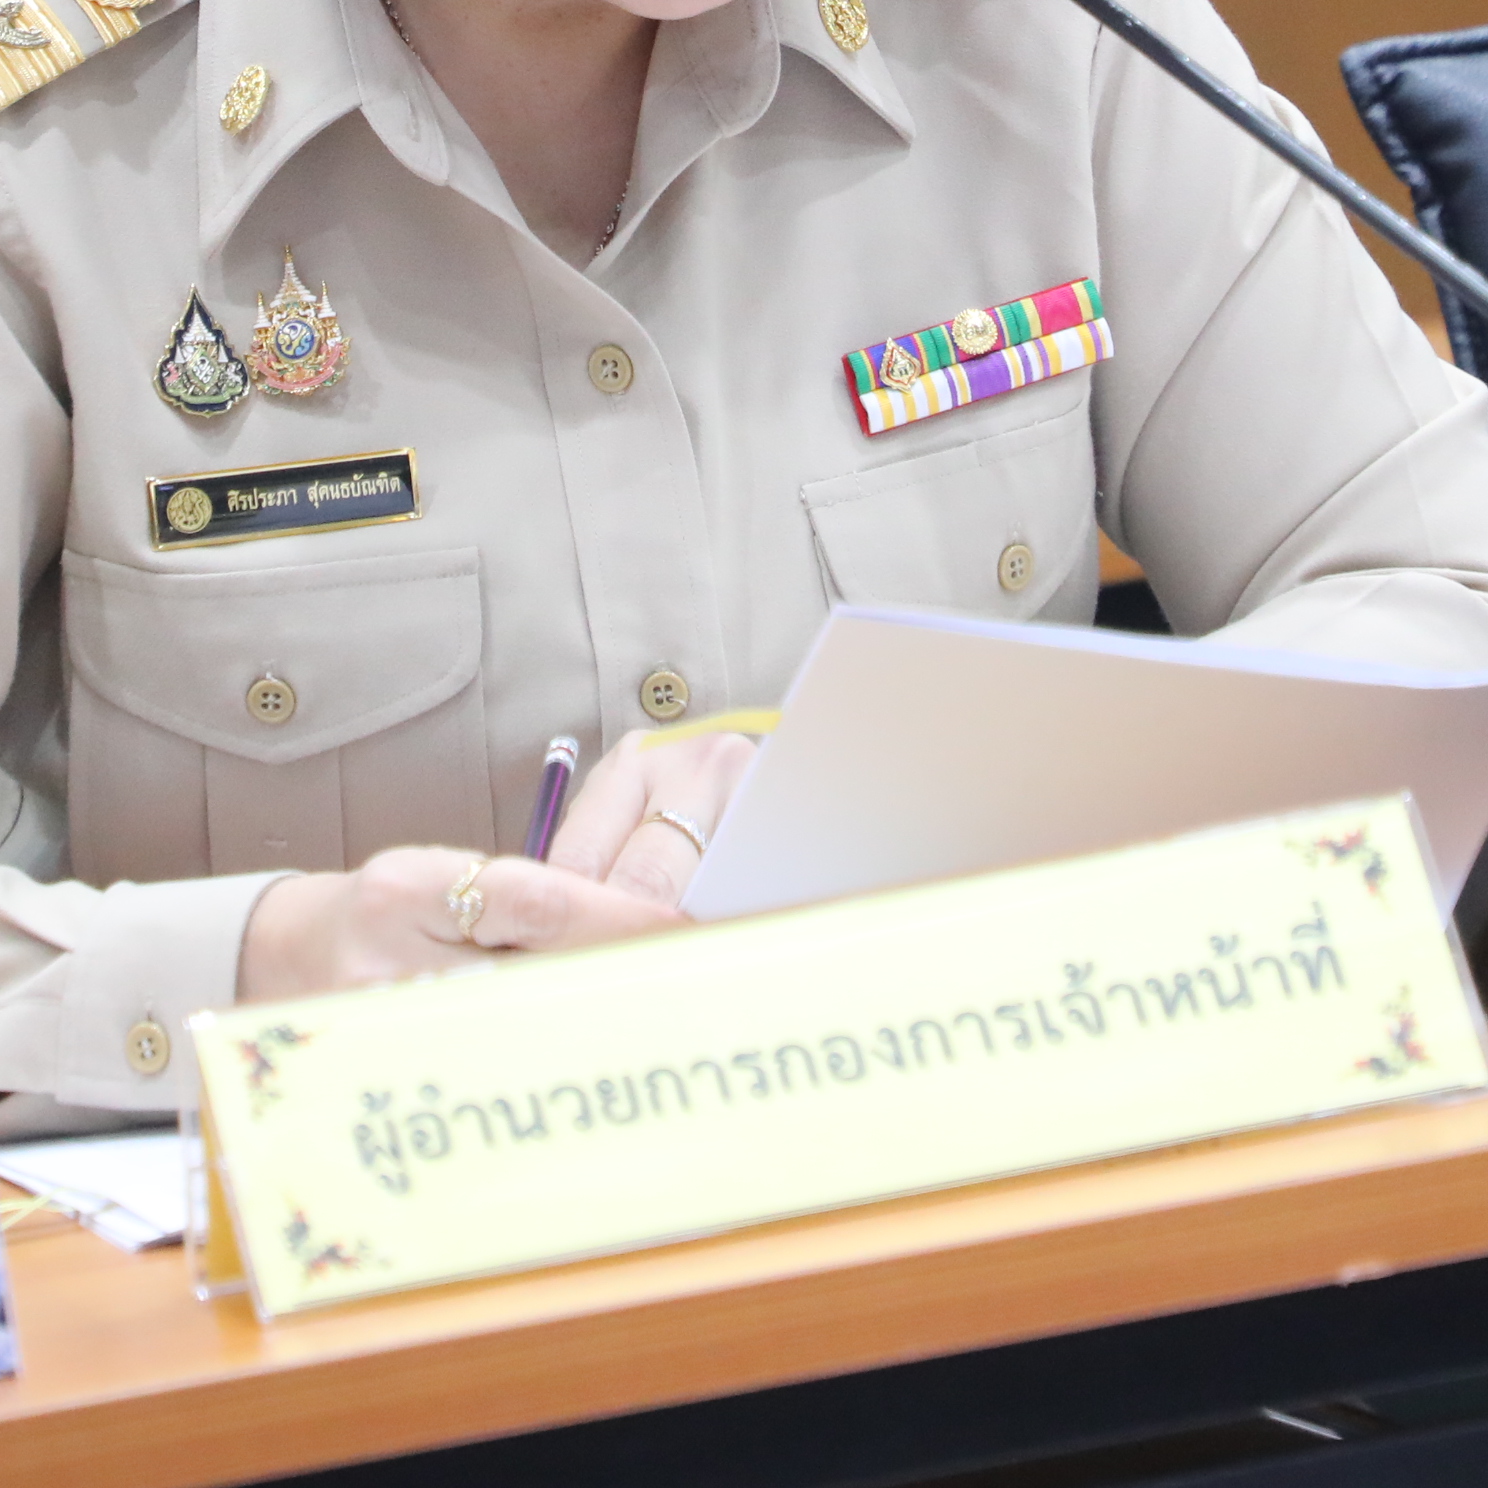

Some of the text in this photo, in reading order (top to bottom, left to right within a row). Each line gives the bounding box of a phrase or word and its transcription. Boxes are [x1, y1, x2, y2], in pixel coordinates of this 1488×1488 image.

[226, 471, 402, 513] ศิรประภา สุคนธบัณฑิต
[352, 900, 1347, 1197] ผู้อำนวยการกองการเจ้าหน้าที่
